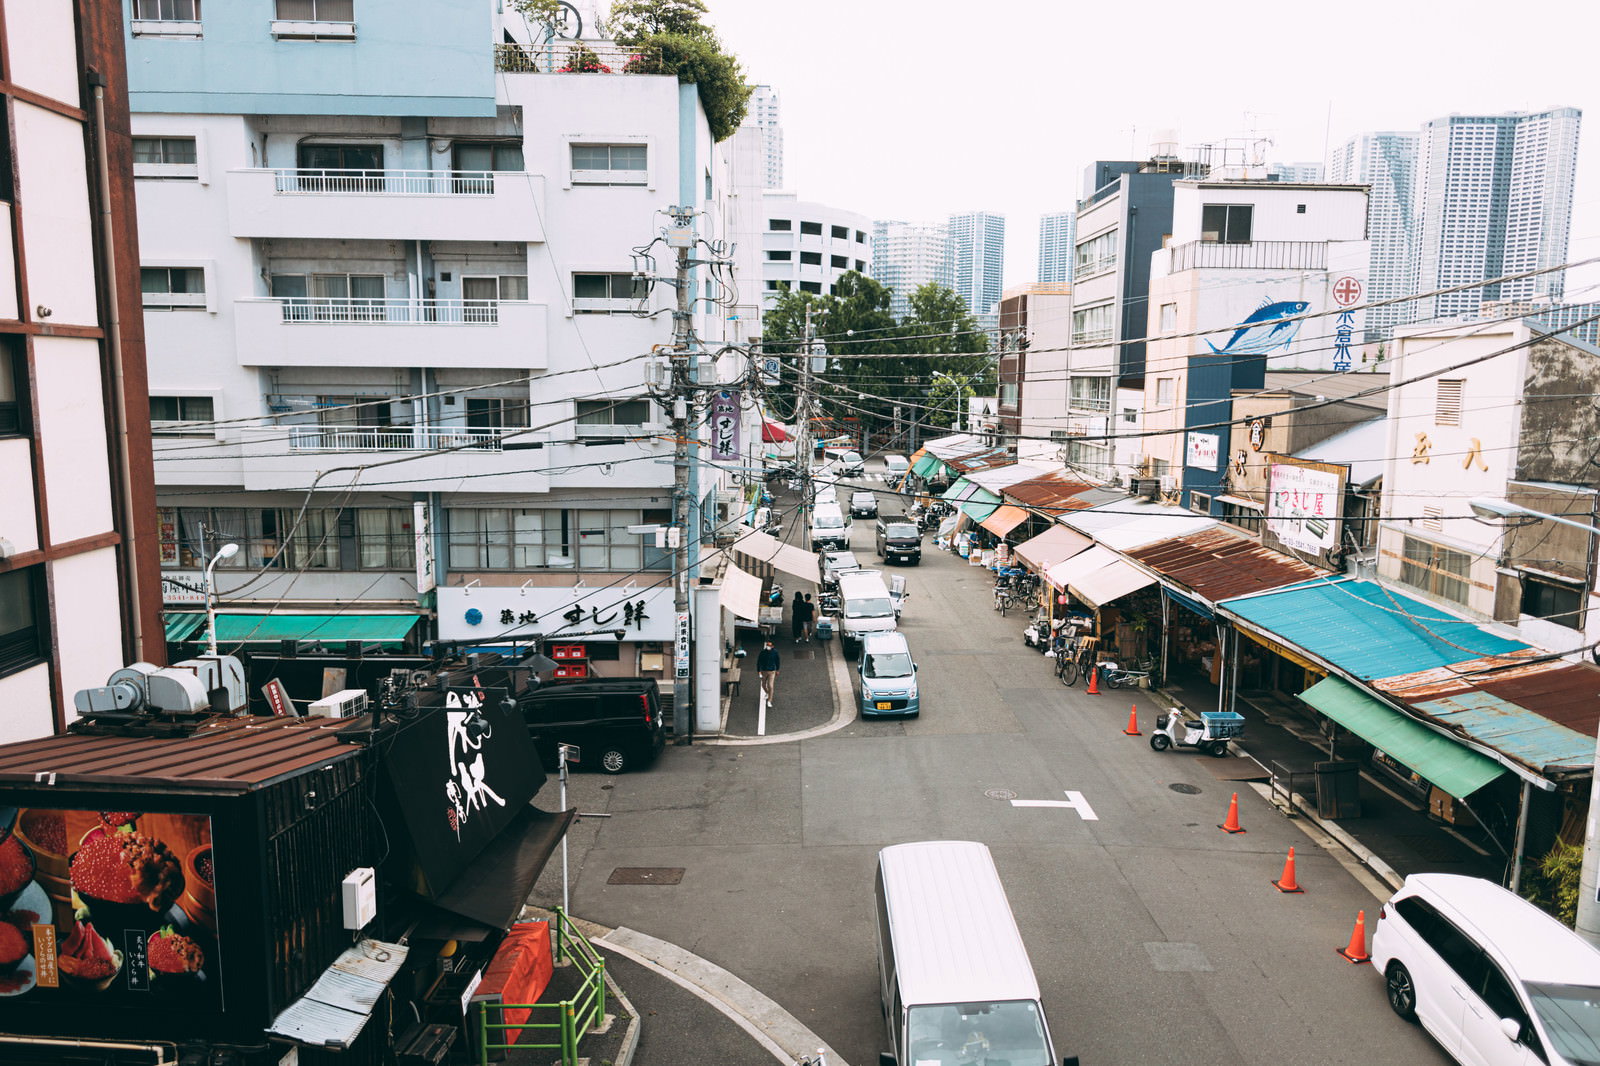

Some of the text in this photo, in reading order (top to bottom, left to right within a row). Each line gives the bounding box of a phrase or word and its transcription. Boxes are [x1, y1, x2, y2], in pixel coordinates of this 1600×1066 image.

[719, 417, 733, 456] すし鮮
[1281, 488, 1324, 515] つきじ屋
[500, 600, 650, 631] 築地 すし鮮
[129, 952, 139, 985] いくら丼
